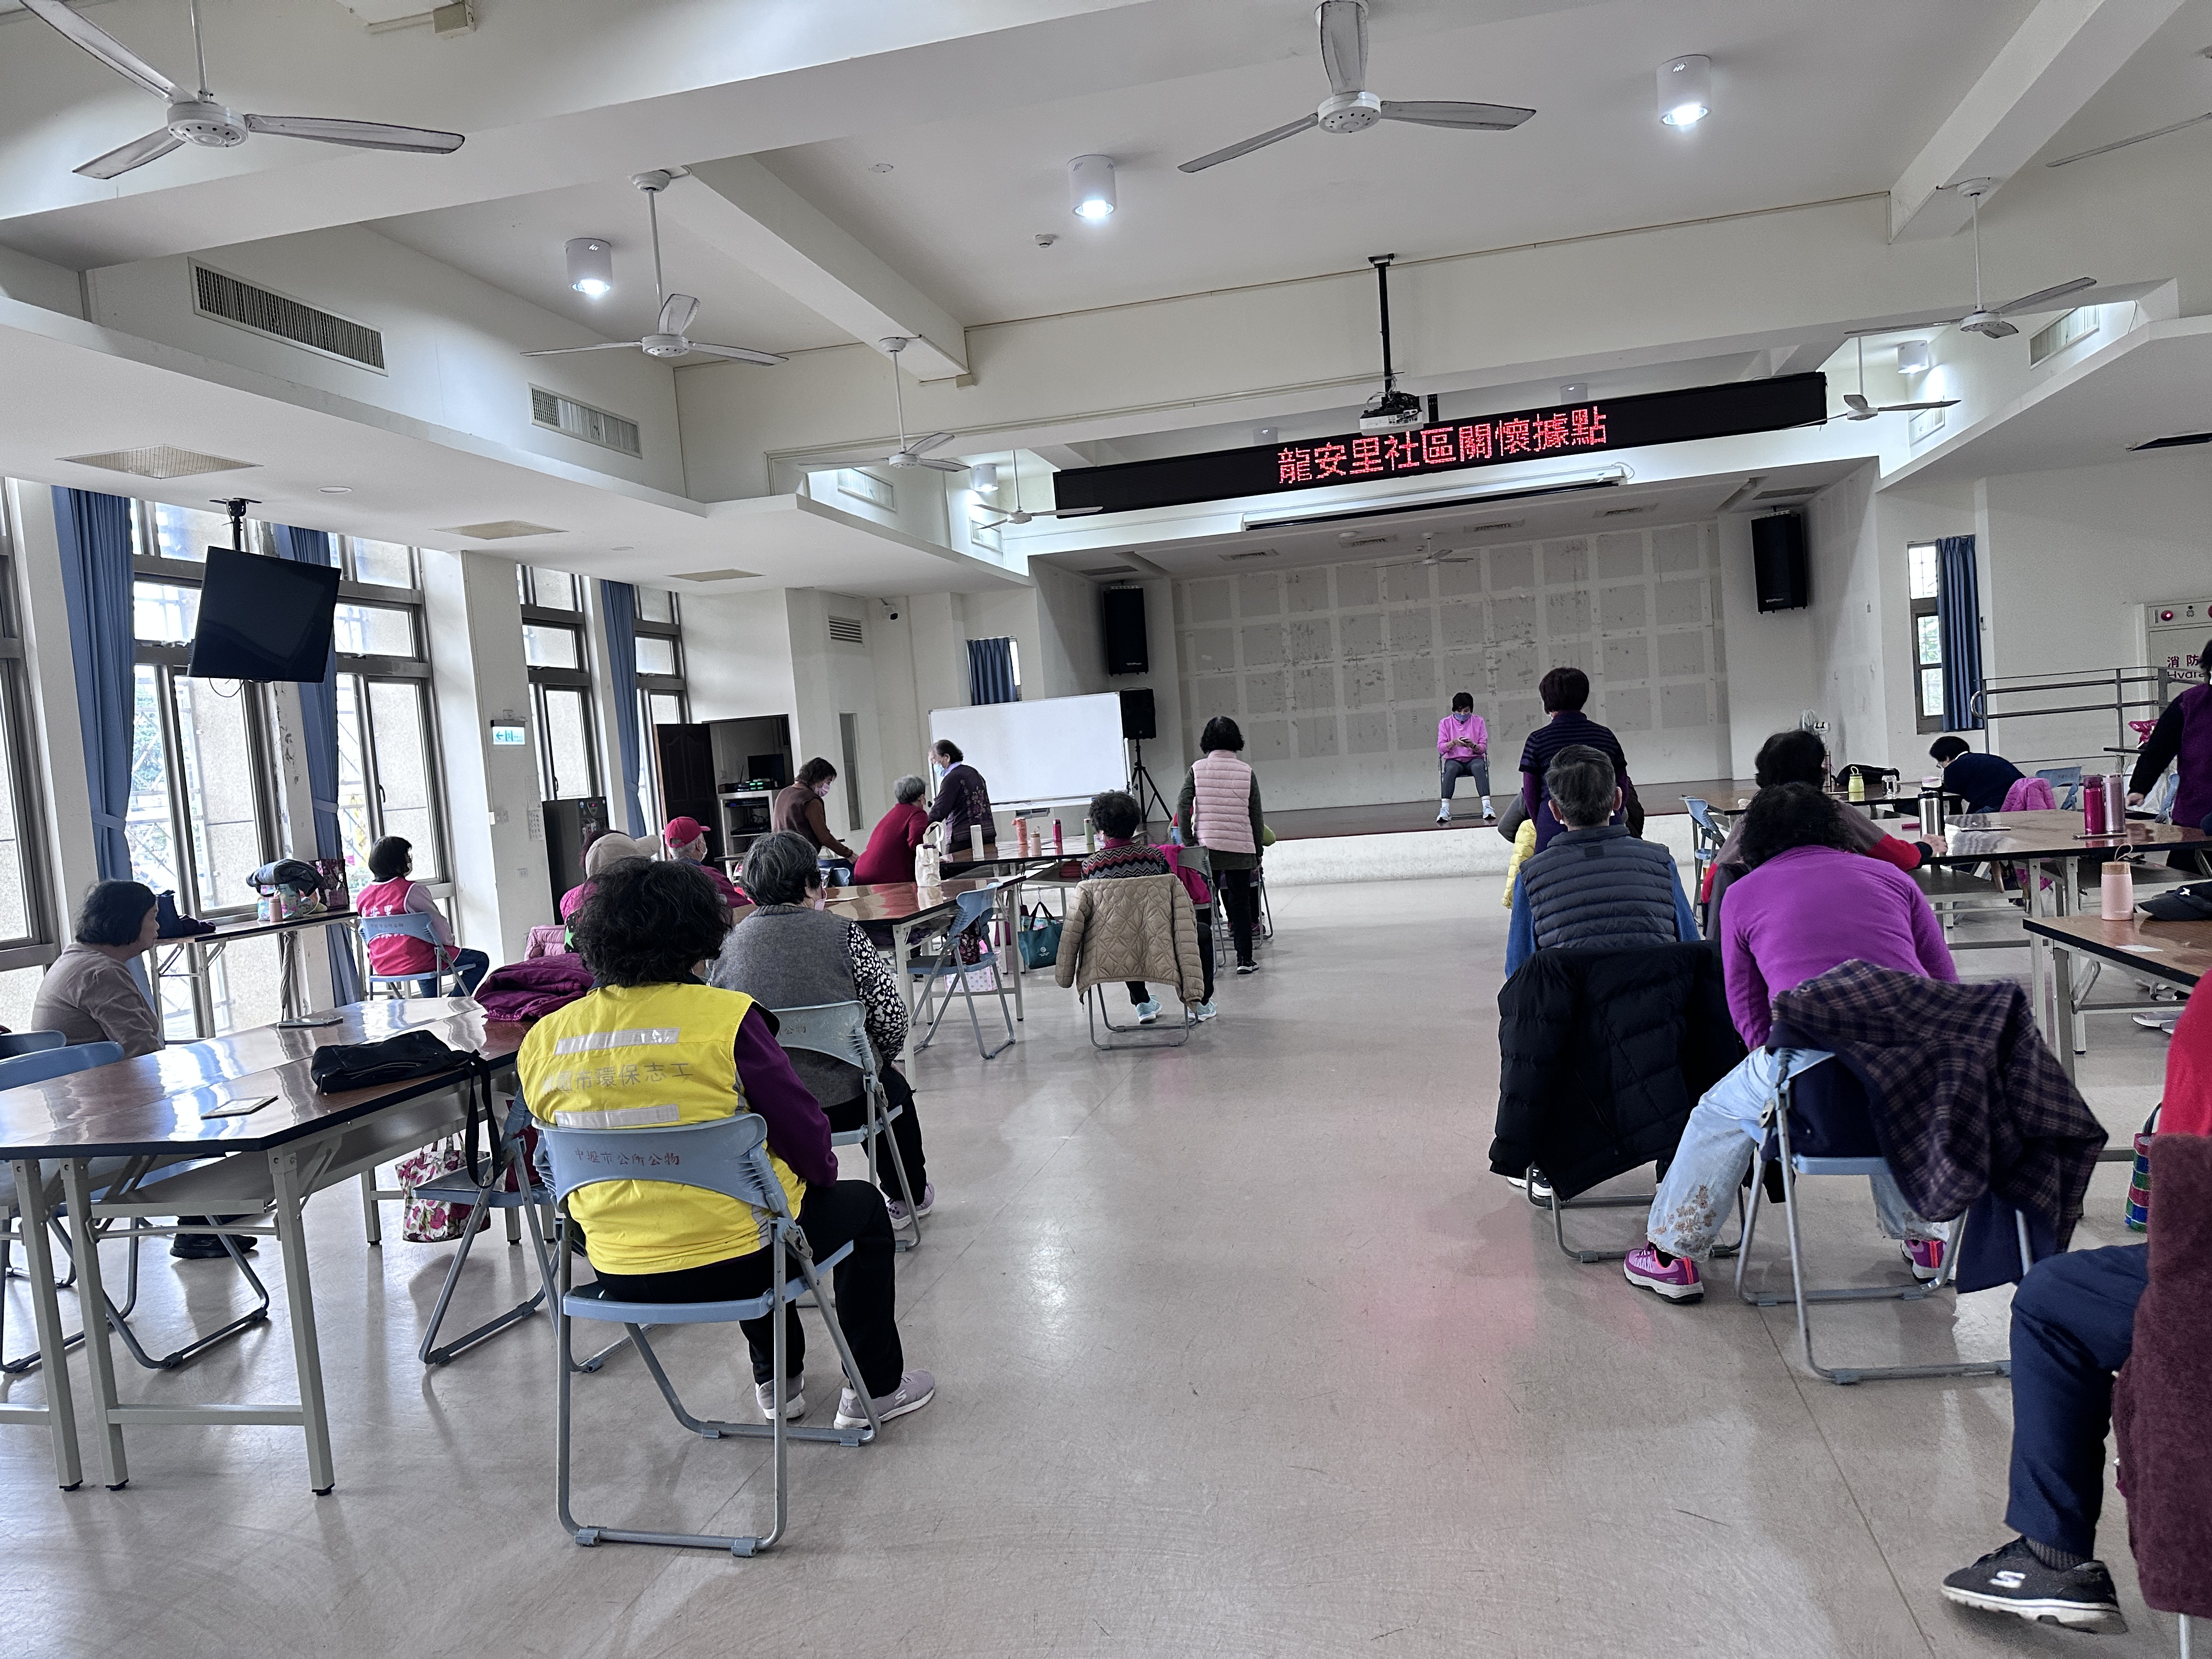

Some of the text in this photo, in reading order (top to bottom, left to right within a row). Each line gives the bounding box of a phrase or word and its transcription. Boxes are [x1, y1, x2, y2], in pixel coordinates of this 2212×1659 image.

[1278, 406, 1607, 484] 龍安里社區關懷據點
